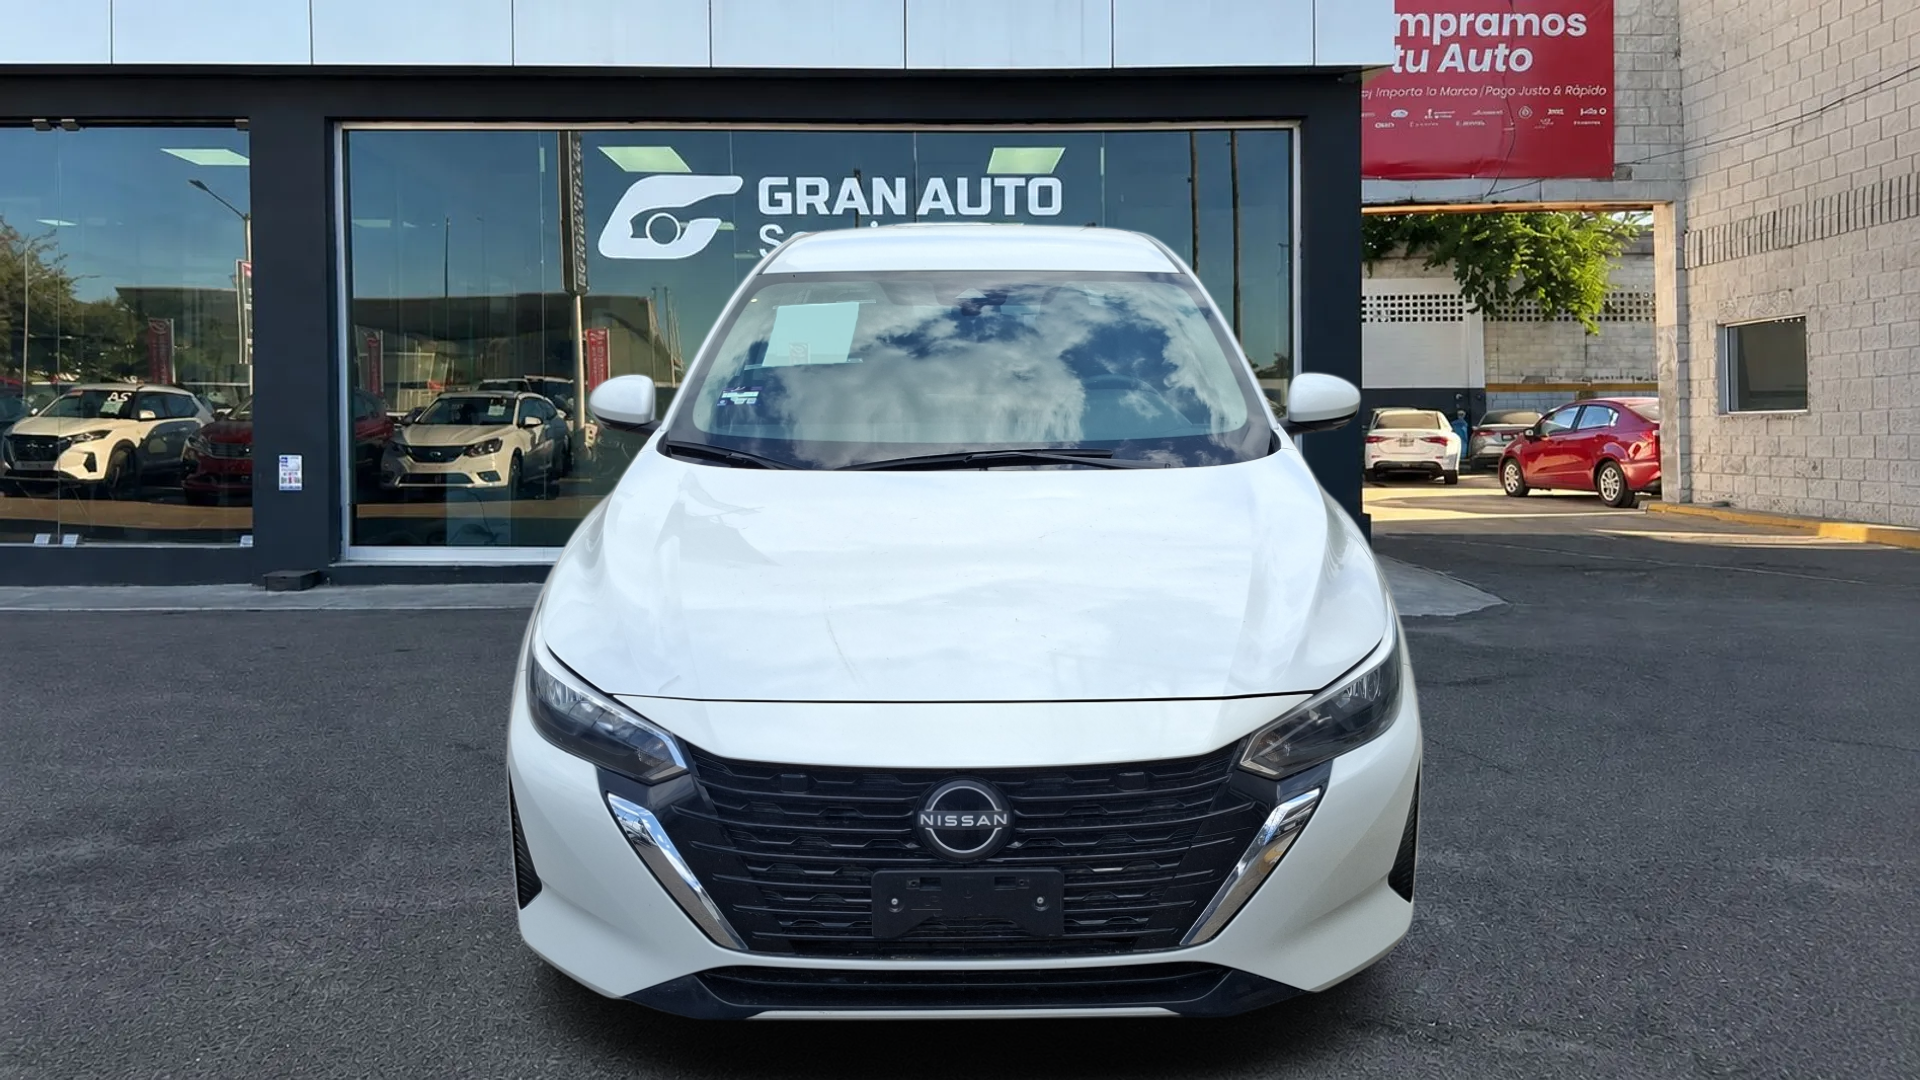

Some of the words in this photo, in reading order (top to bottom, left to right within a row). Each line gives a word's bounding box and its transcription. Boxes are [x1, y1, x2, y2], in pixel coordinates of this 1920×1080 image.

[1392, 44, 1430, 73] tu
[1437, 43, 1533, 73] Auto
[1376, 86, 1424, 99] Importa
[1426, 86, 1437, 97] la
[1518, 85, 1551, 96] Justo
[1553, 86, 1562, 95] &
[1565, 84, 1607, 98] Rápido
[758, 176, 907, 215] GRAN
[916, 177, 1062, 216] AUTO
[920, 813, 1008, 827] NISSAN
